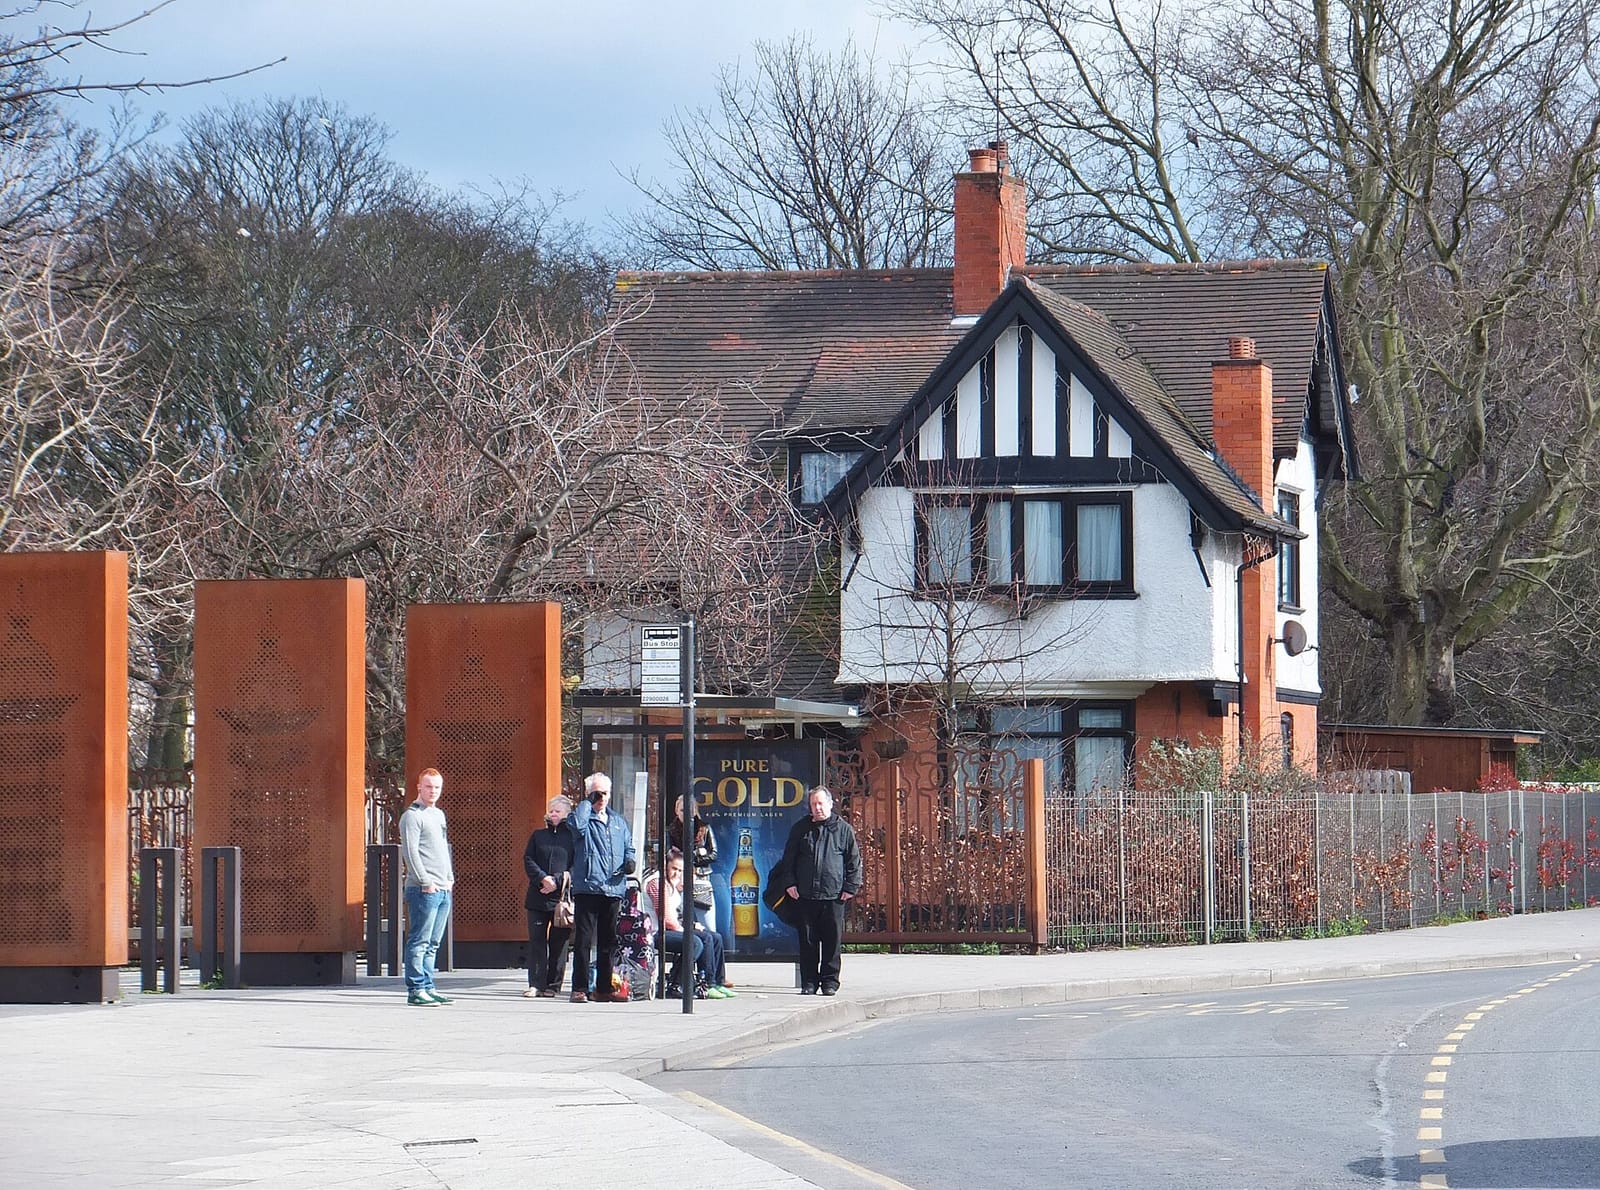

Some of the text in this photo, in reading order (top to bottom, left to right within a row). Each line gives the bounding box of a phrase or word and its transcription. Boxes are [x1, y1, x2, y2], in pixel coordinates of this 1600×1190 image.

[721, 759, 769, 773] PURE
[692, 776, 804, 807] GOLD
[734, 891, 756, 899] GOLD
